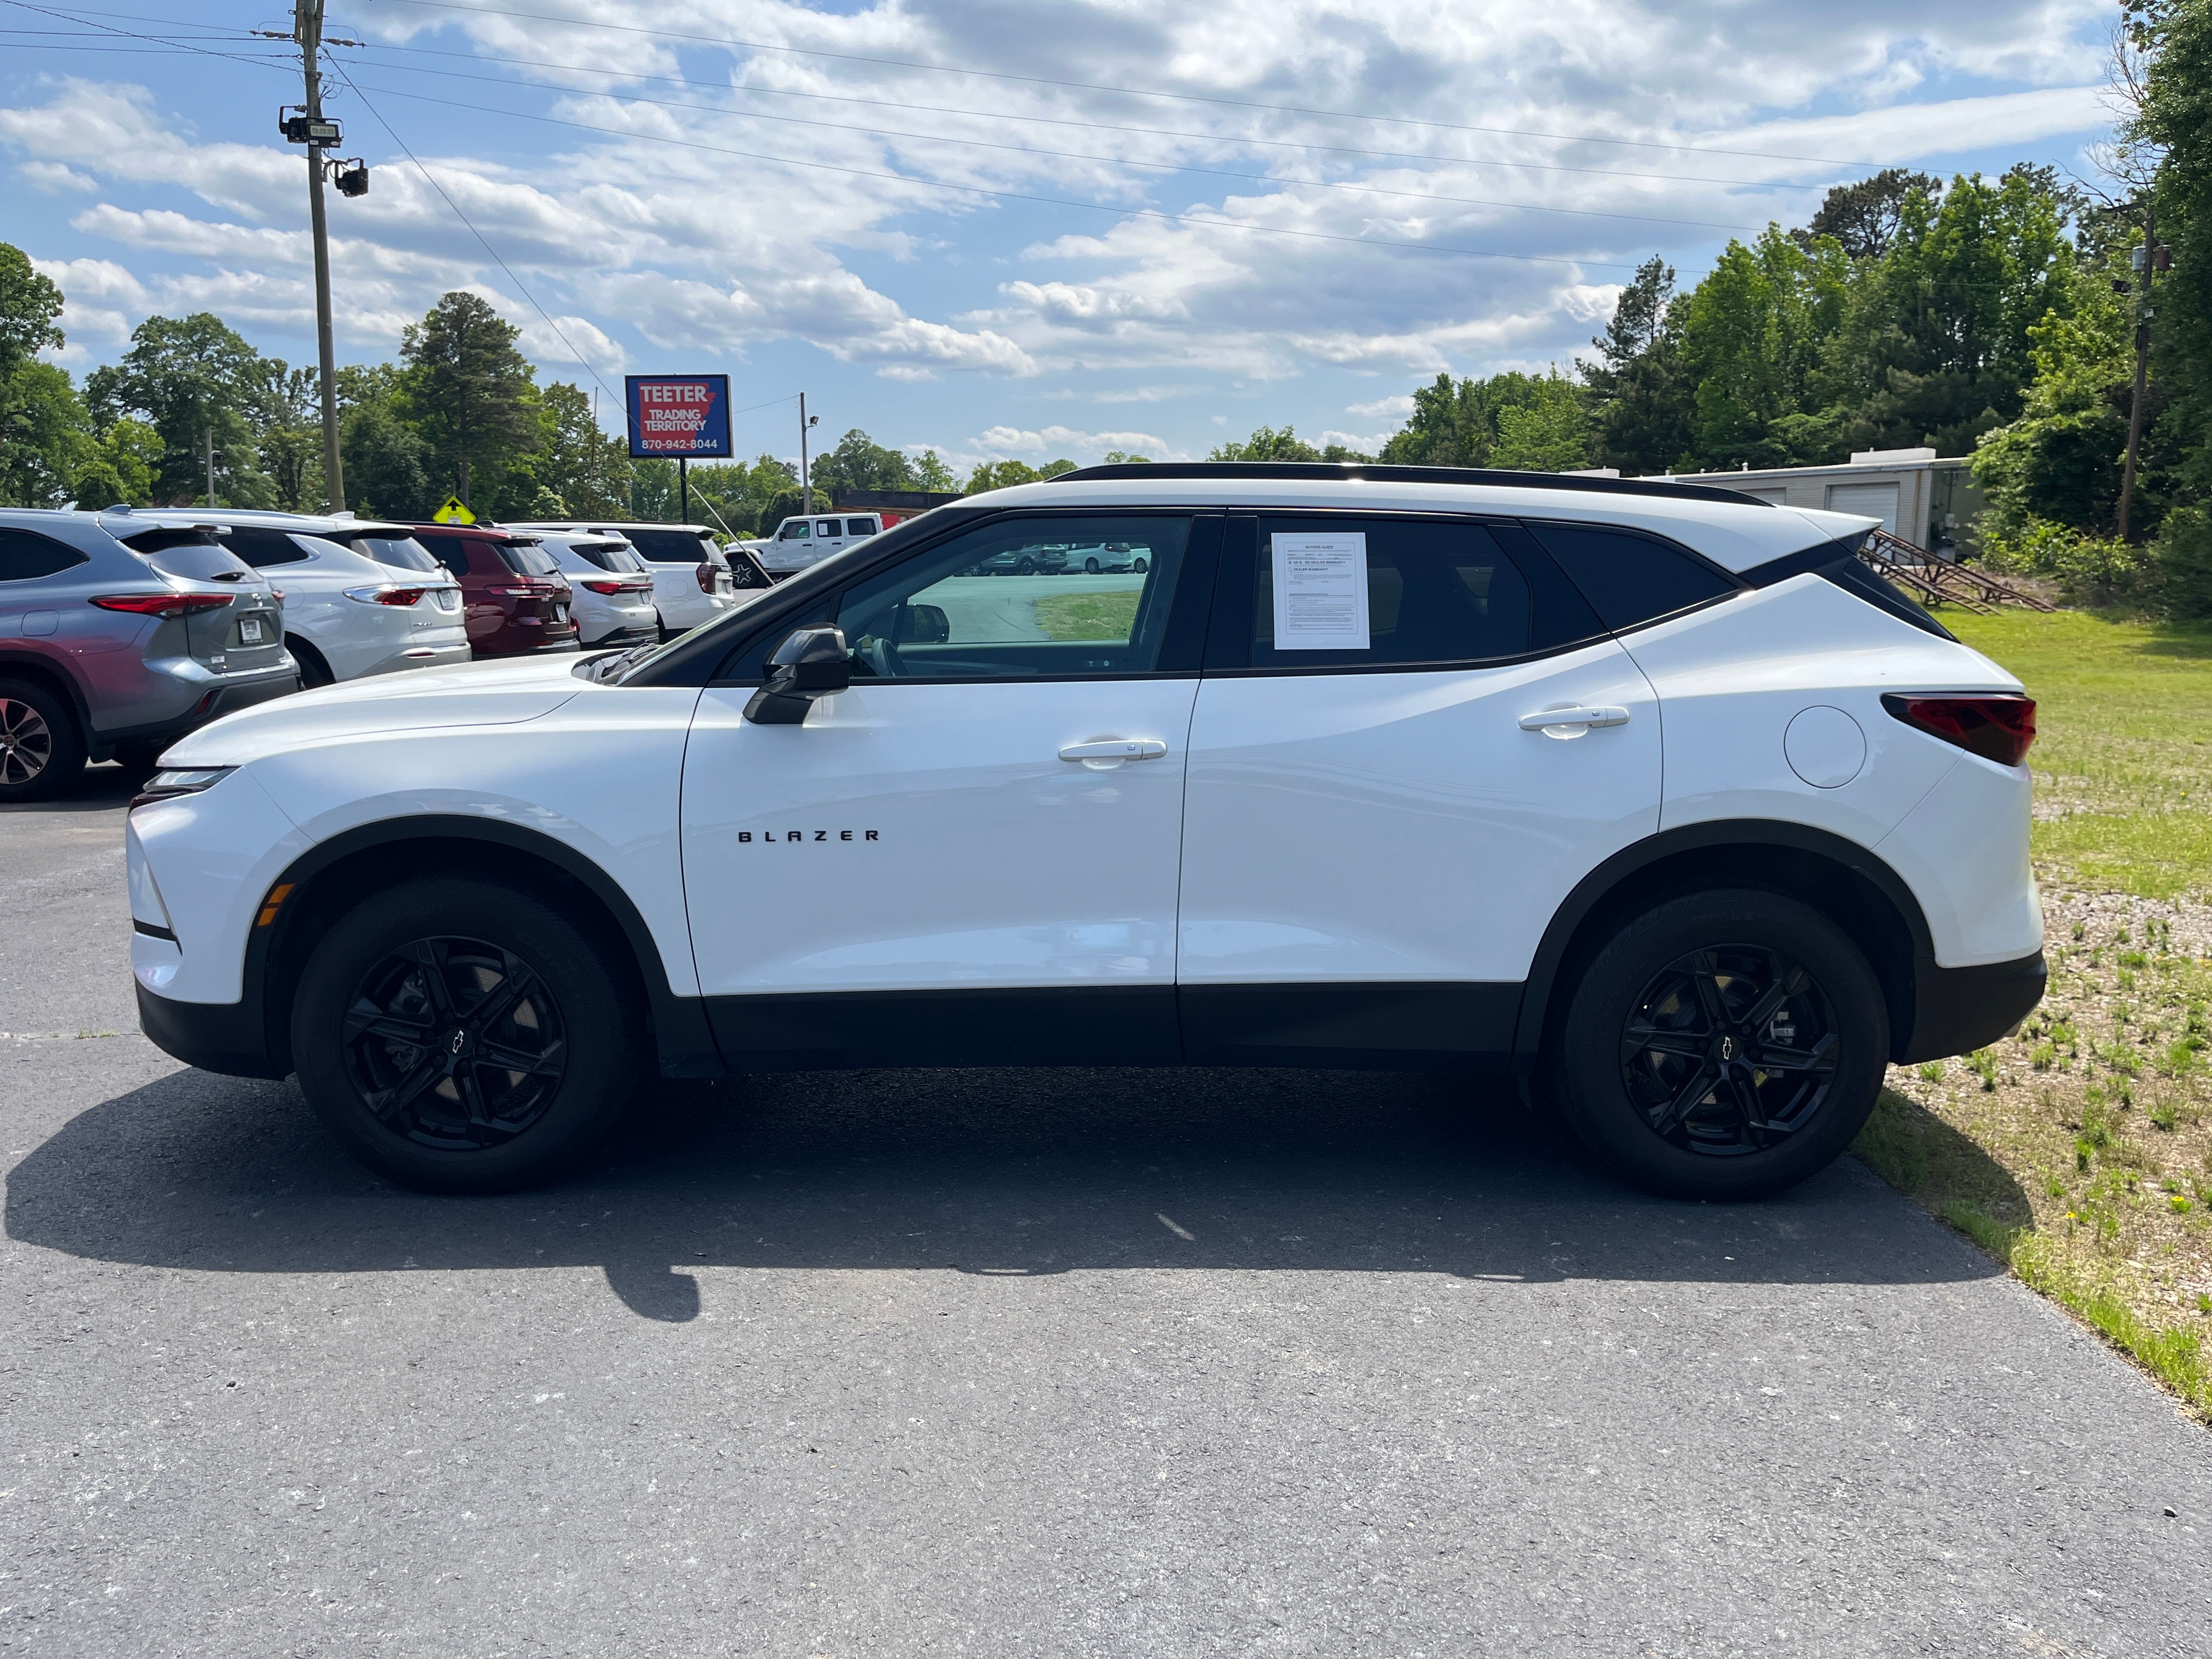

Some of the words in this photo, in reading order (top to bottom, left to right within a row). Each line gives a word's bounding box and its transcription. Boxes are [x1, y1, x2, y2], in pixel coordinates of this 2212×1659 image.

[640, 386, 708, 402] TEETER
[649, 409, 701, 420] TRADING
[644, 420, 707, 431] TERRITORY
[641, 439, 718, 449] 870-942-8044
[738, 830, 878, 842] BLAZER
